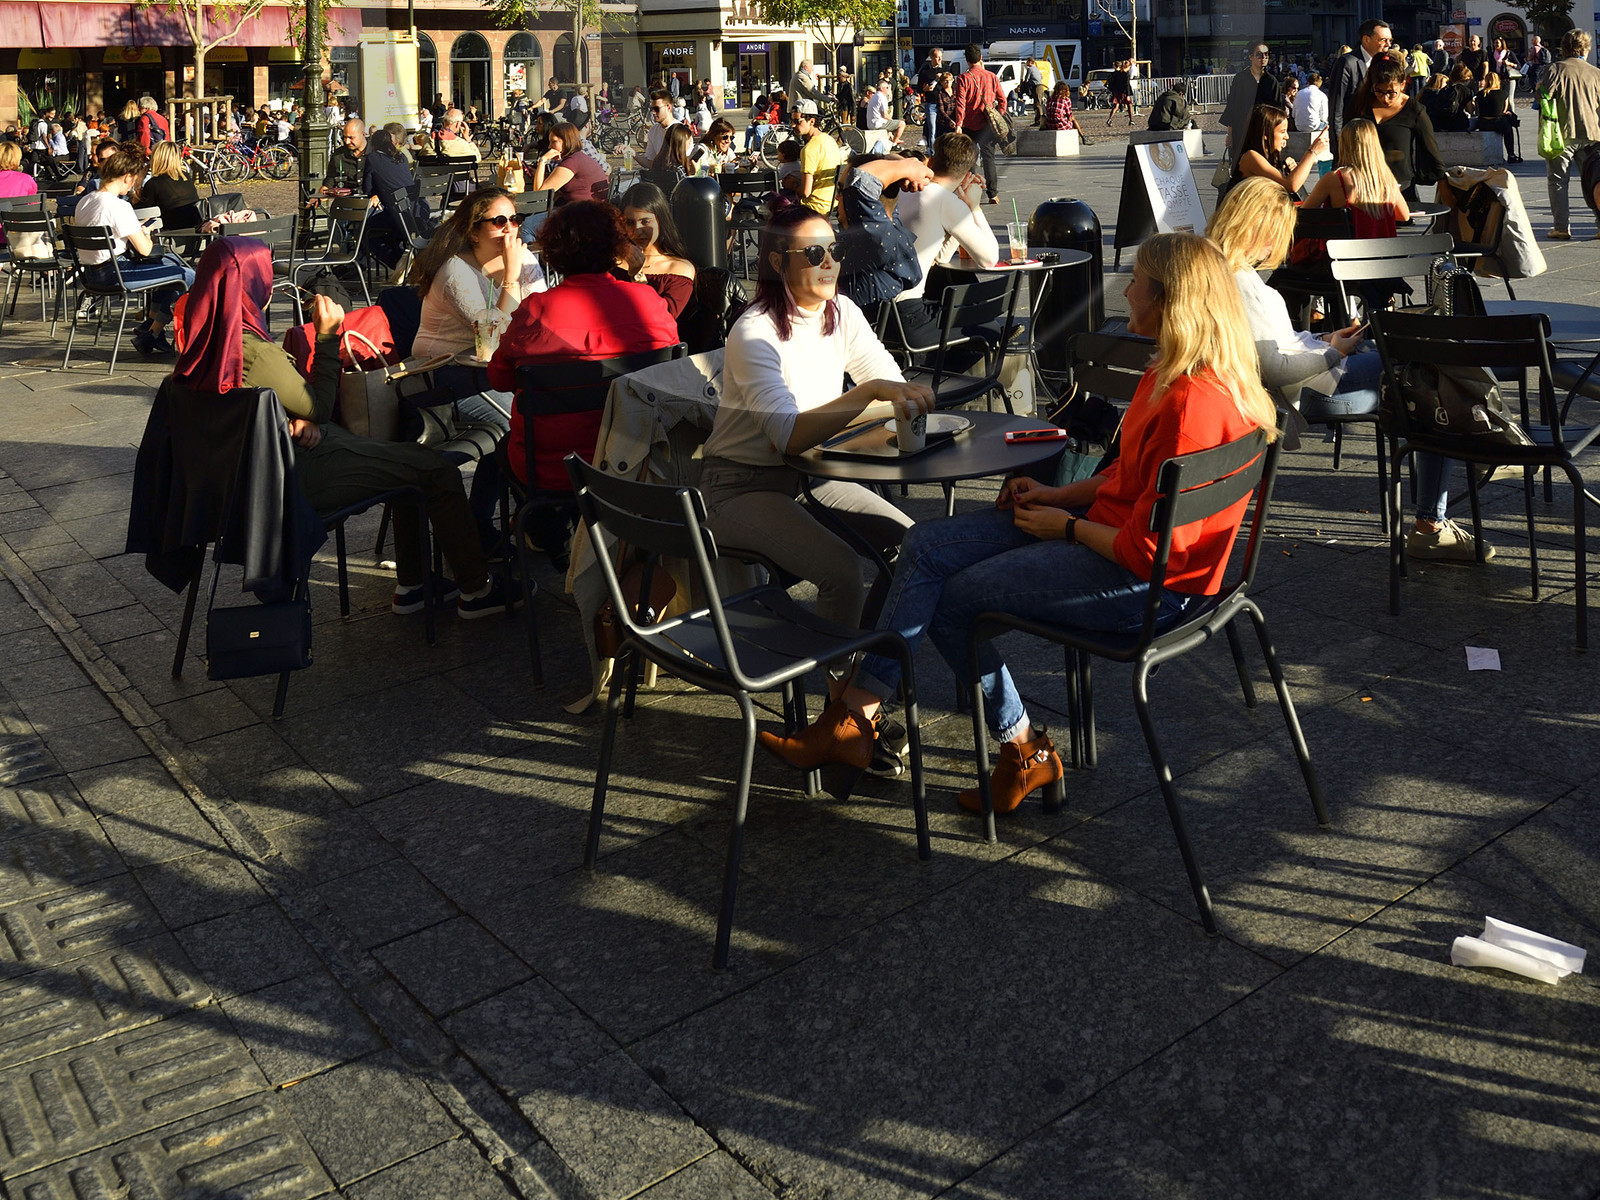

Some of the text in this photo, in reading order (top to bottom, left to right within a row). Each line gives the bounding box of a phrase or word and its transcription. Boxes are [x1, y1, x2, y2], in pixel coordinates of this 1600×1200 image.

[662, 45, 694, 56] ANDRÉ
[746, 42, 765, 50] ANDRÉ
[1158, 185, 1189, 199] TASSE
[1164, 197, 1192, 209] OMPTE
